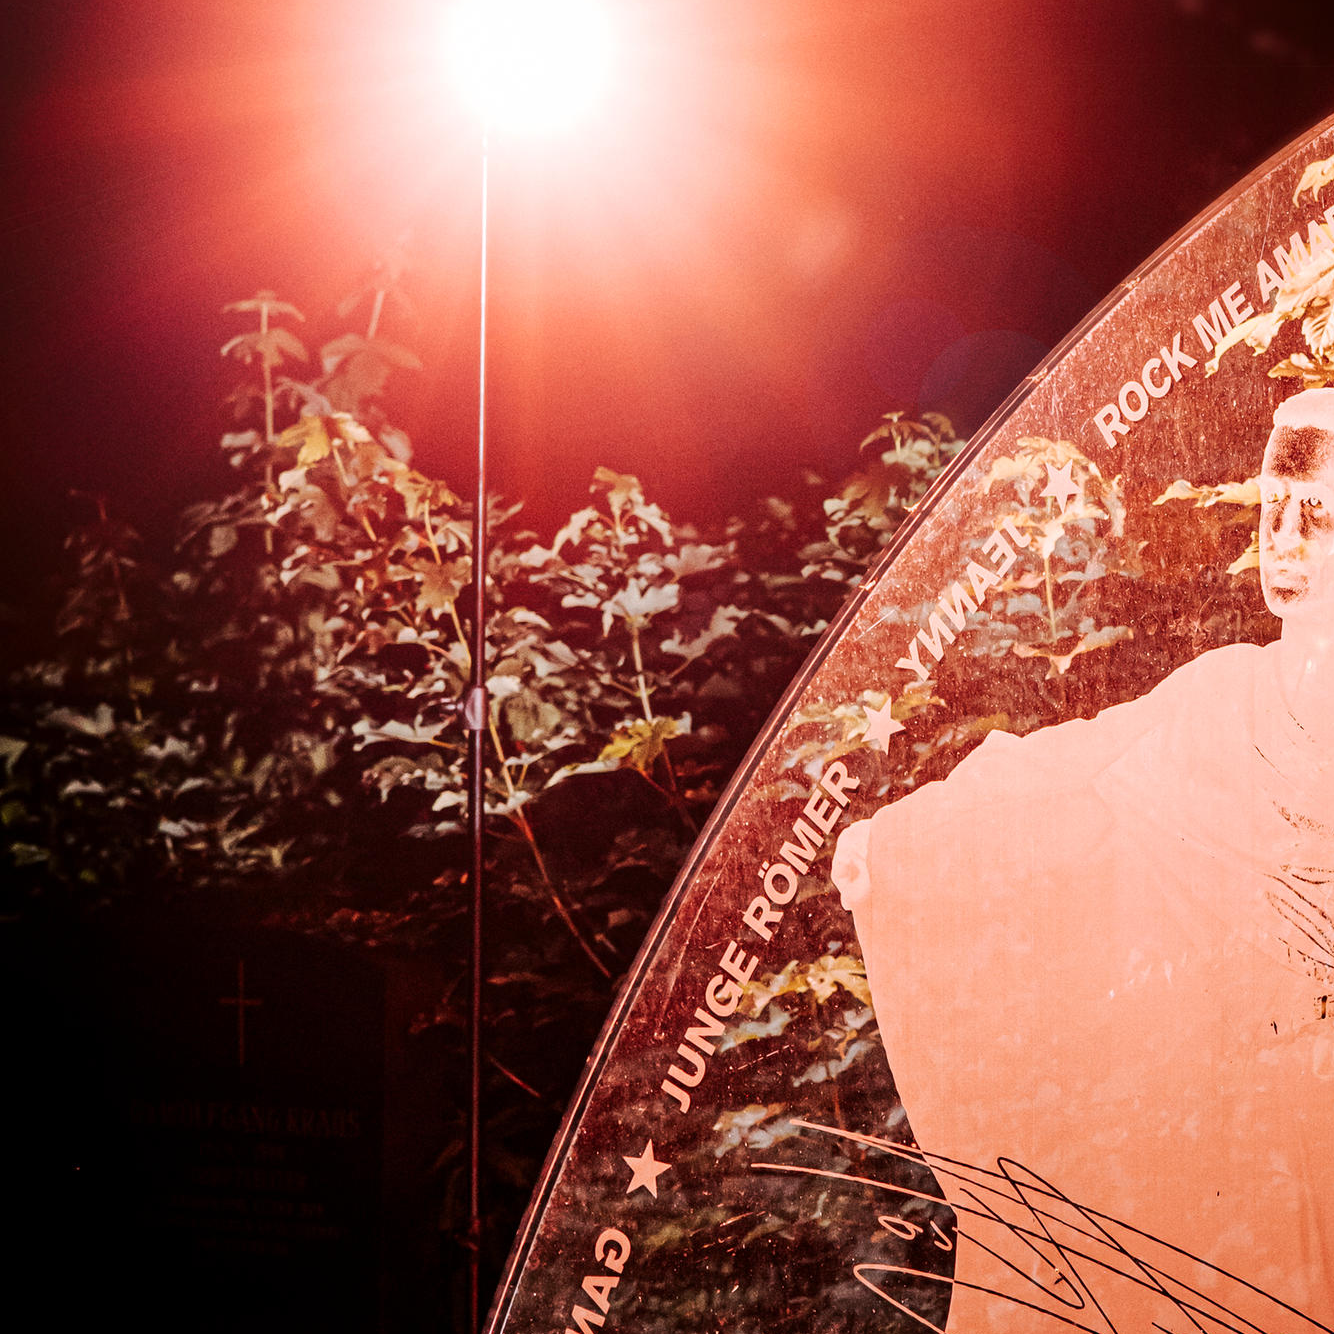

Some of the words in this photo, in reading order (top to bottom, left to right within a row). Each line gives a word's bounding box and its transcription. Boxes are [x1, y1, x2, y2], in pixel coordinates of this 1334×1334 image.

[1093, 331, 1198, 449] ROCK
[1192, 281, 1254, 353] ME
[661, 941, 760, 1114] JUNGE
[741, 760, 861, 942] RÖMER
